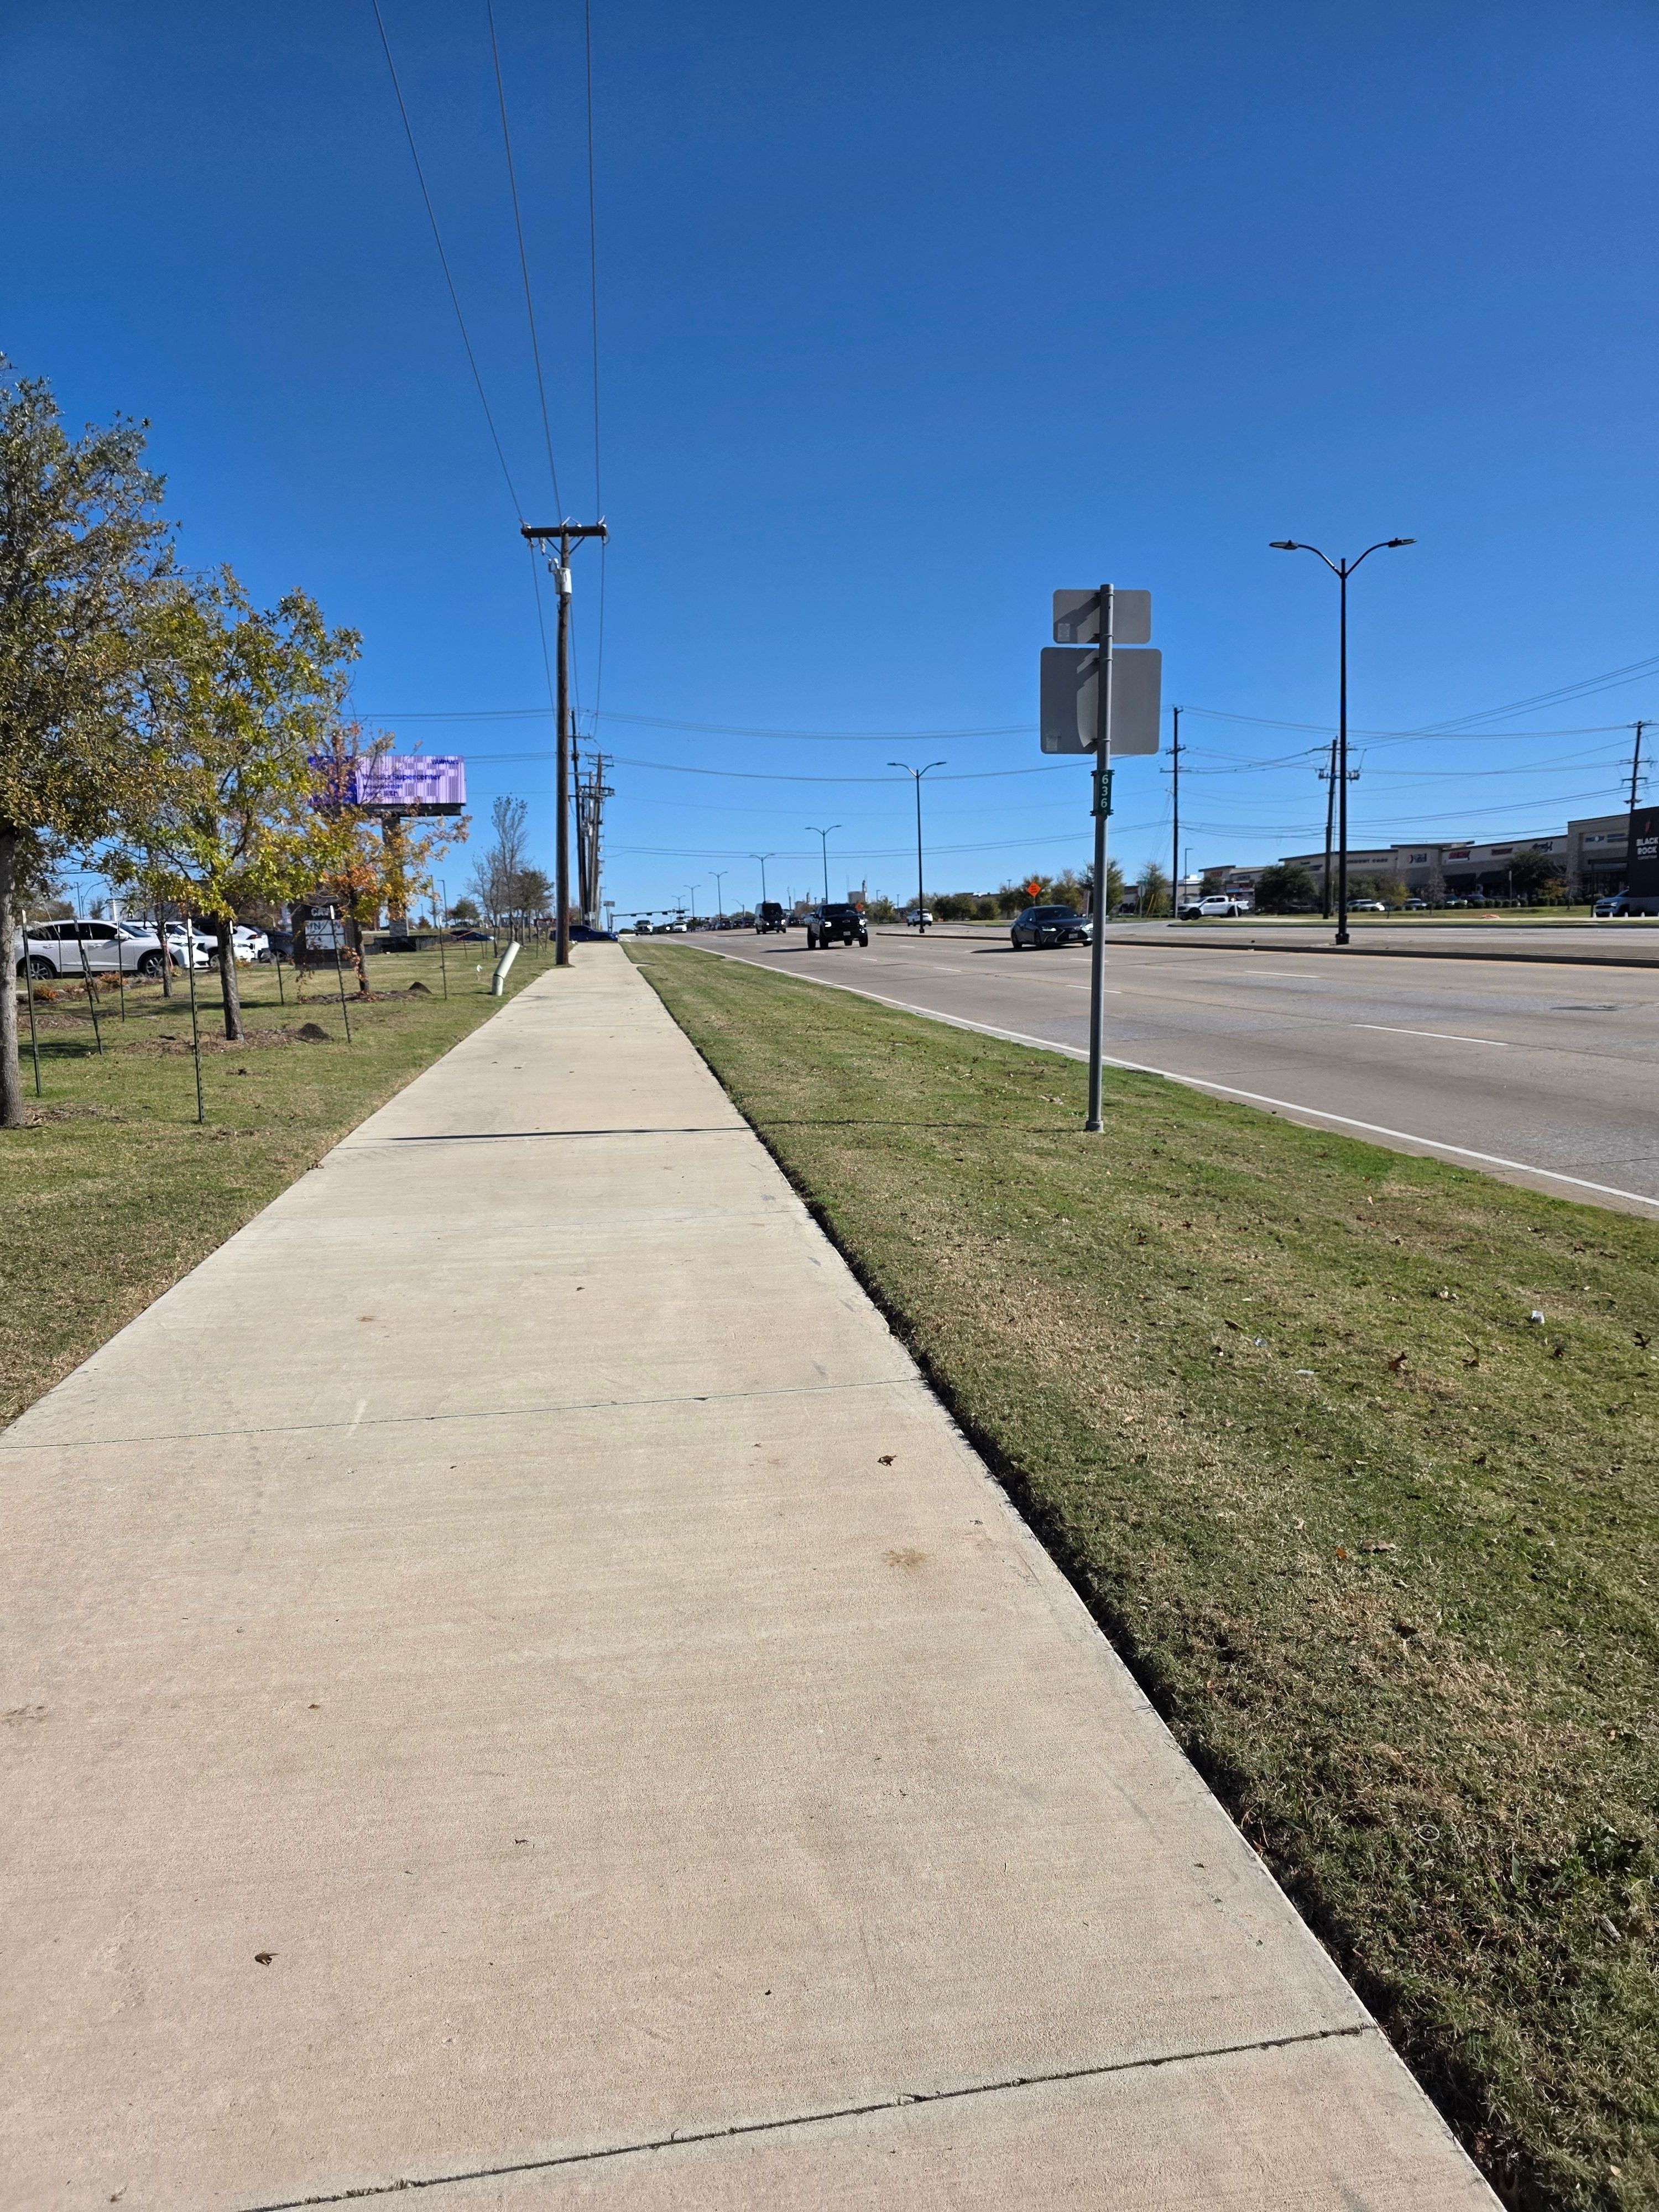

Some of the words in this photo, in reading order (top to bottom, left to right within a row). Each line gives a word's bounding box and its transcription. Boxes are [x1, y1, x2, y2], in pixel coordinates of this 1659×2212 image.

[1100, 774, 1109, 808] 636
[1637, 837, 1658, 846] BLACK
[1637, 846, 1657, 855] ROCK
